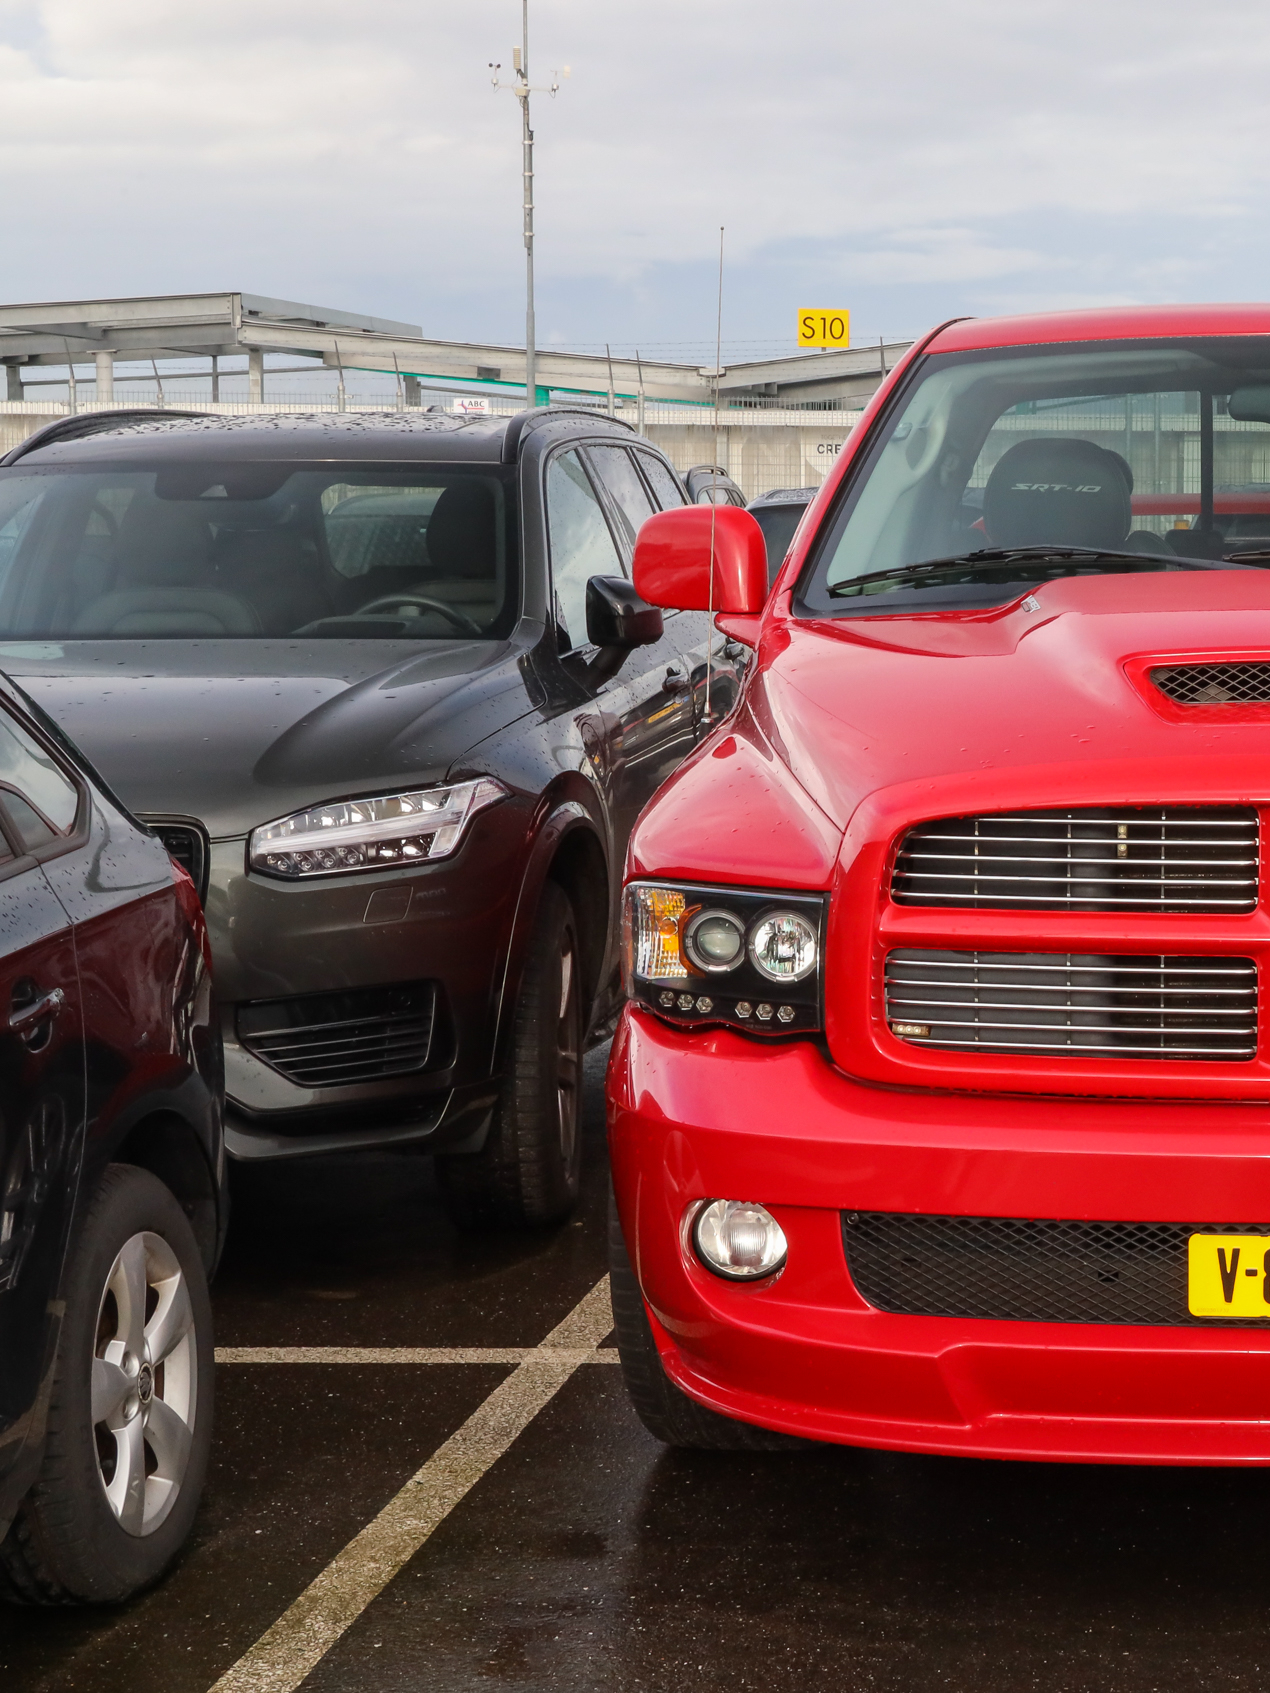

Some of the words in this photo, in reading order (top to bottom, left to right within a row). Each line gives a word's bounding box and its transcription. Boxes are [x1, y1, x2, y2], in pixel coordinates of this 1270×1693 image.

[801, 316, 845, 340] S10
[467, 400, 485, 408] ABC
[1011, 483, 1102, 493] SRT-10
